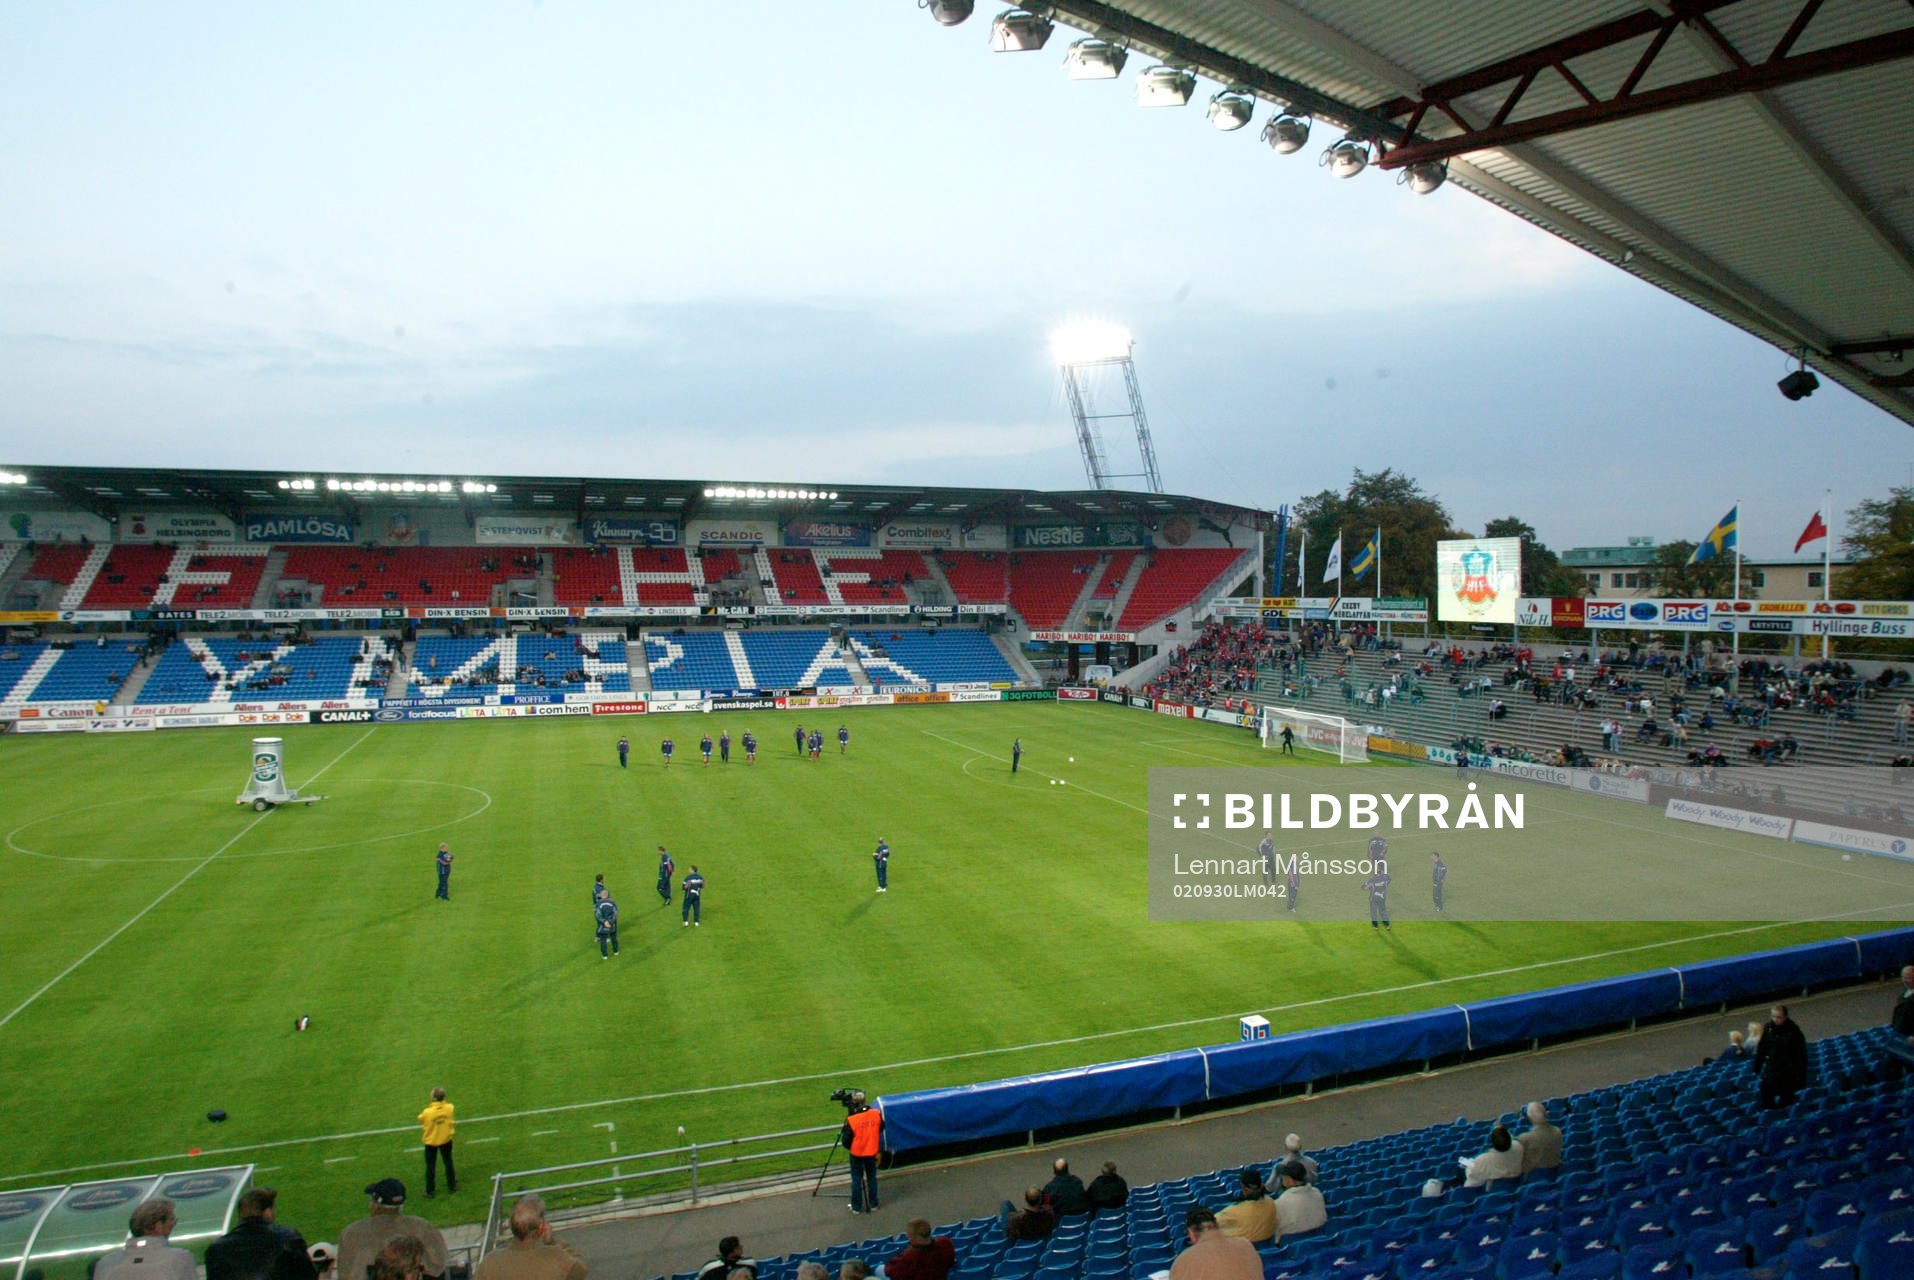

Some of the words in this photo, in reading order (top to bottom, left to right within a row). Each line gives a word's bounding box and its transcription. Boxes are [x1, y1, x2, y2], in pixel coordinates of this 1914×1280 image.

[171, 518, 216, 527] OLYMPIA
[156, 529, 232, 538] HELSINGBORG
[247, 516, 350, 541] RAMLÖSA
[700, 530, 764, 540] SCANDIC
[427, 609, 452, 617] DIN-X
[454, 608, 488, 617] BENSIN
[870, 604, 909, 614] Scandlines
[959, 604, 974, 613] Din
[976, 603, 986, 613] Bil
[1587, 605, 1625, 619] PRG
[157, 610, 193, 619] BATES
[1664, 607, 1707, 621] PRG
[1812, 620, 1868, 636] Hyllinge
[1870, 621, 1907, 635] Buss
[1036, 631, 1062, 641] HARIBO
[1068, 631, 1095, 641] HARIBO
[1100, 632, 1128, 642] HARIBO
[882, 685, 928, 694] EURONICS
[514, 694, 551, 704] PROFFICE
[960, 692, 997, 700] Scandlines
[1022, 690, 1058, 700] FOTBOLL
[131, 706, 157, 715] Rent
[234, 703, 263, 712] Allers
[278, 702, 307, 711] Allers
[321, 701, 350, 710] Allers
[539, 706, 564, 714] com
[565, 703, 589, 713] hem
[595, 703, 643, 712] Firestone
[713, 701, 773, 711] svenskaspel.se
[1157, 702, 1187, 718] maxell
[48, 707, 94, 718] Canon
[321, 711, 371, 722] CANAL+
[1498, 760, 1567, 785] nicorette
[1673, 801, 1706, 820] Woody
[1709, 807, 1743, 827] Woody
[1749, 813, 1786, 834] Woody
[1829, 830, 1888, 850] PAPYRUS
